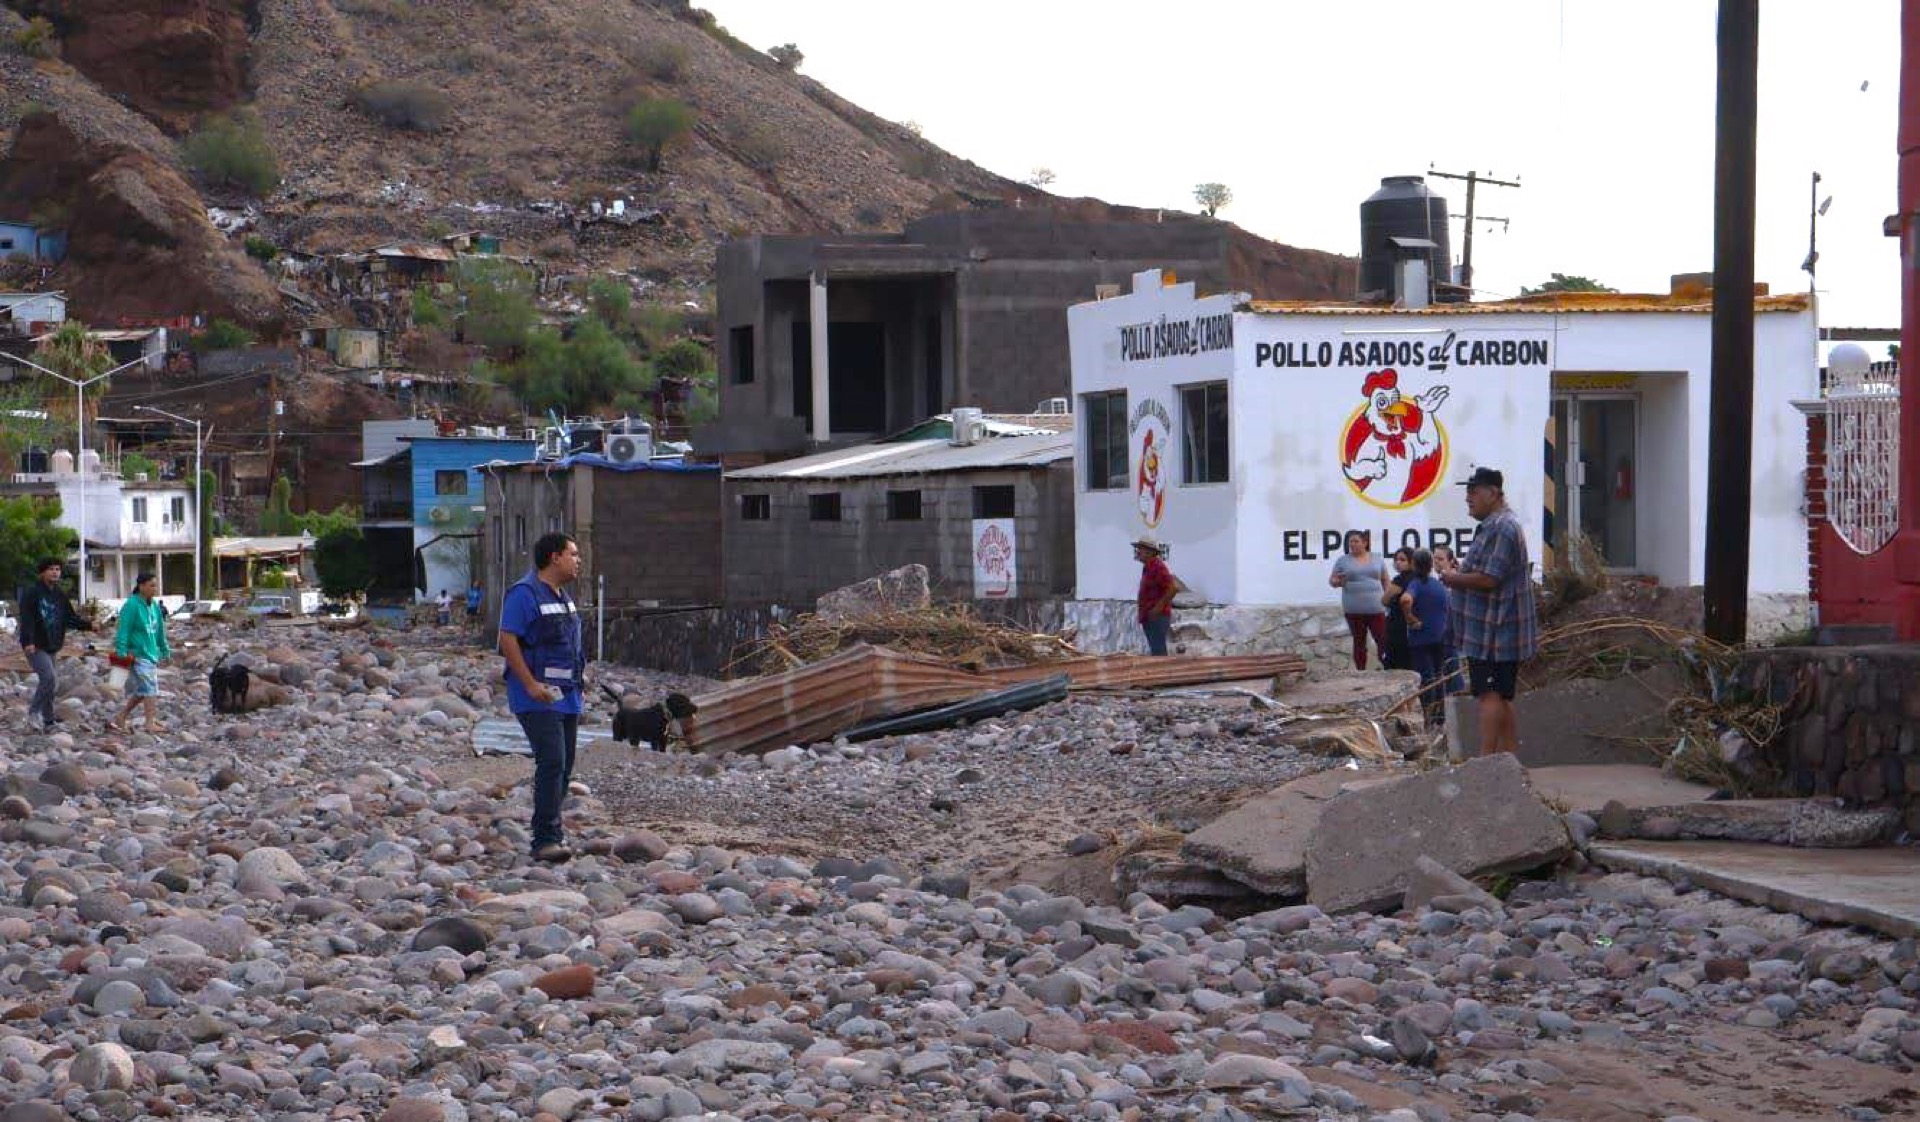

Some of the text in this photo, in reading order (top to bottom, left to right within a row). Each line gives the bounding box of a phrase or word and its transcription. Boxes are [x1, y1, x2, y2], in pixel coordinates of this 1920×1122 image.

[1121, 327, 1151, 361] POLLO
[1154, 320, 1190, 358] ASADOS
[1200, 313, 1233, 353] CARBON
[1256, 331, 1548, 371] POLLO ASADOS al CARBON
[1283, 529, 1317, 561] EL
[1428, 526, 1478, 559] RE
